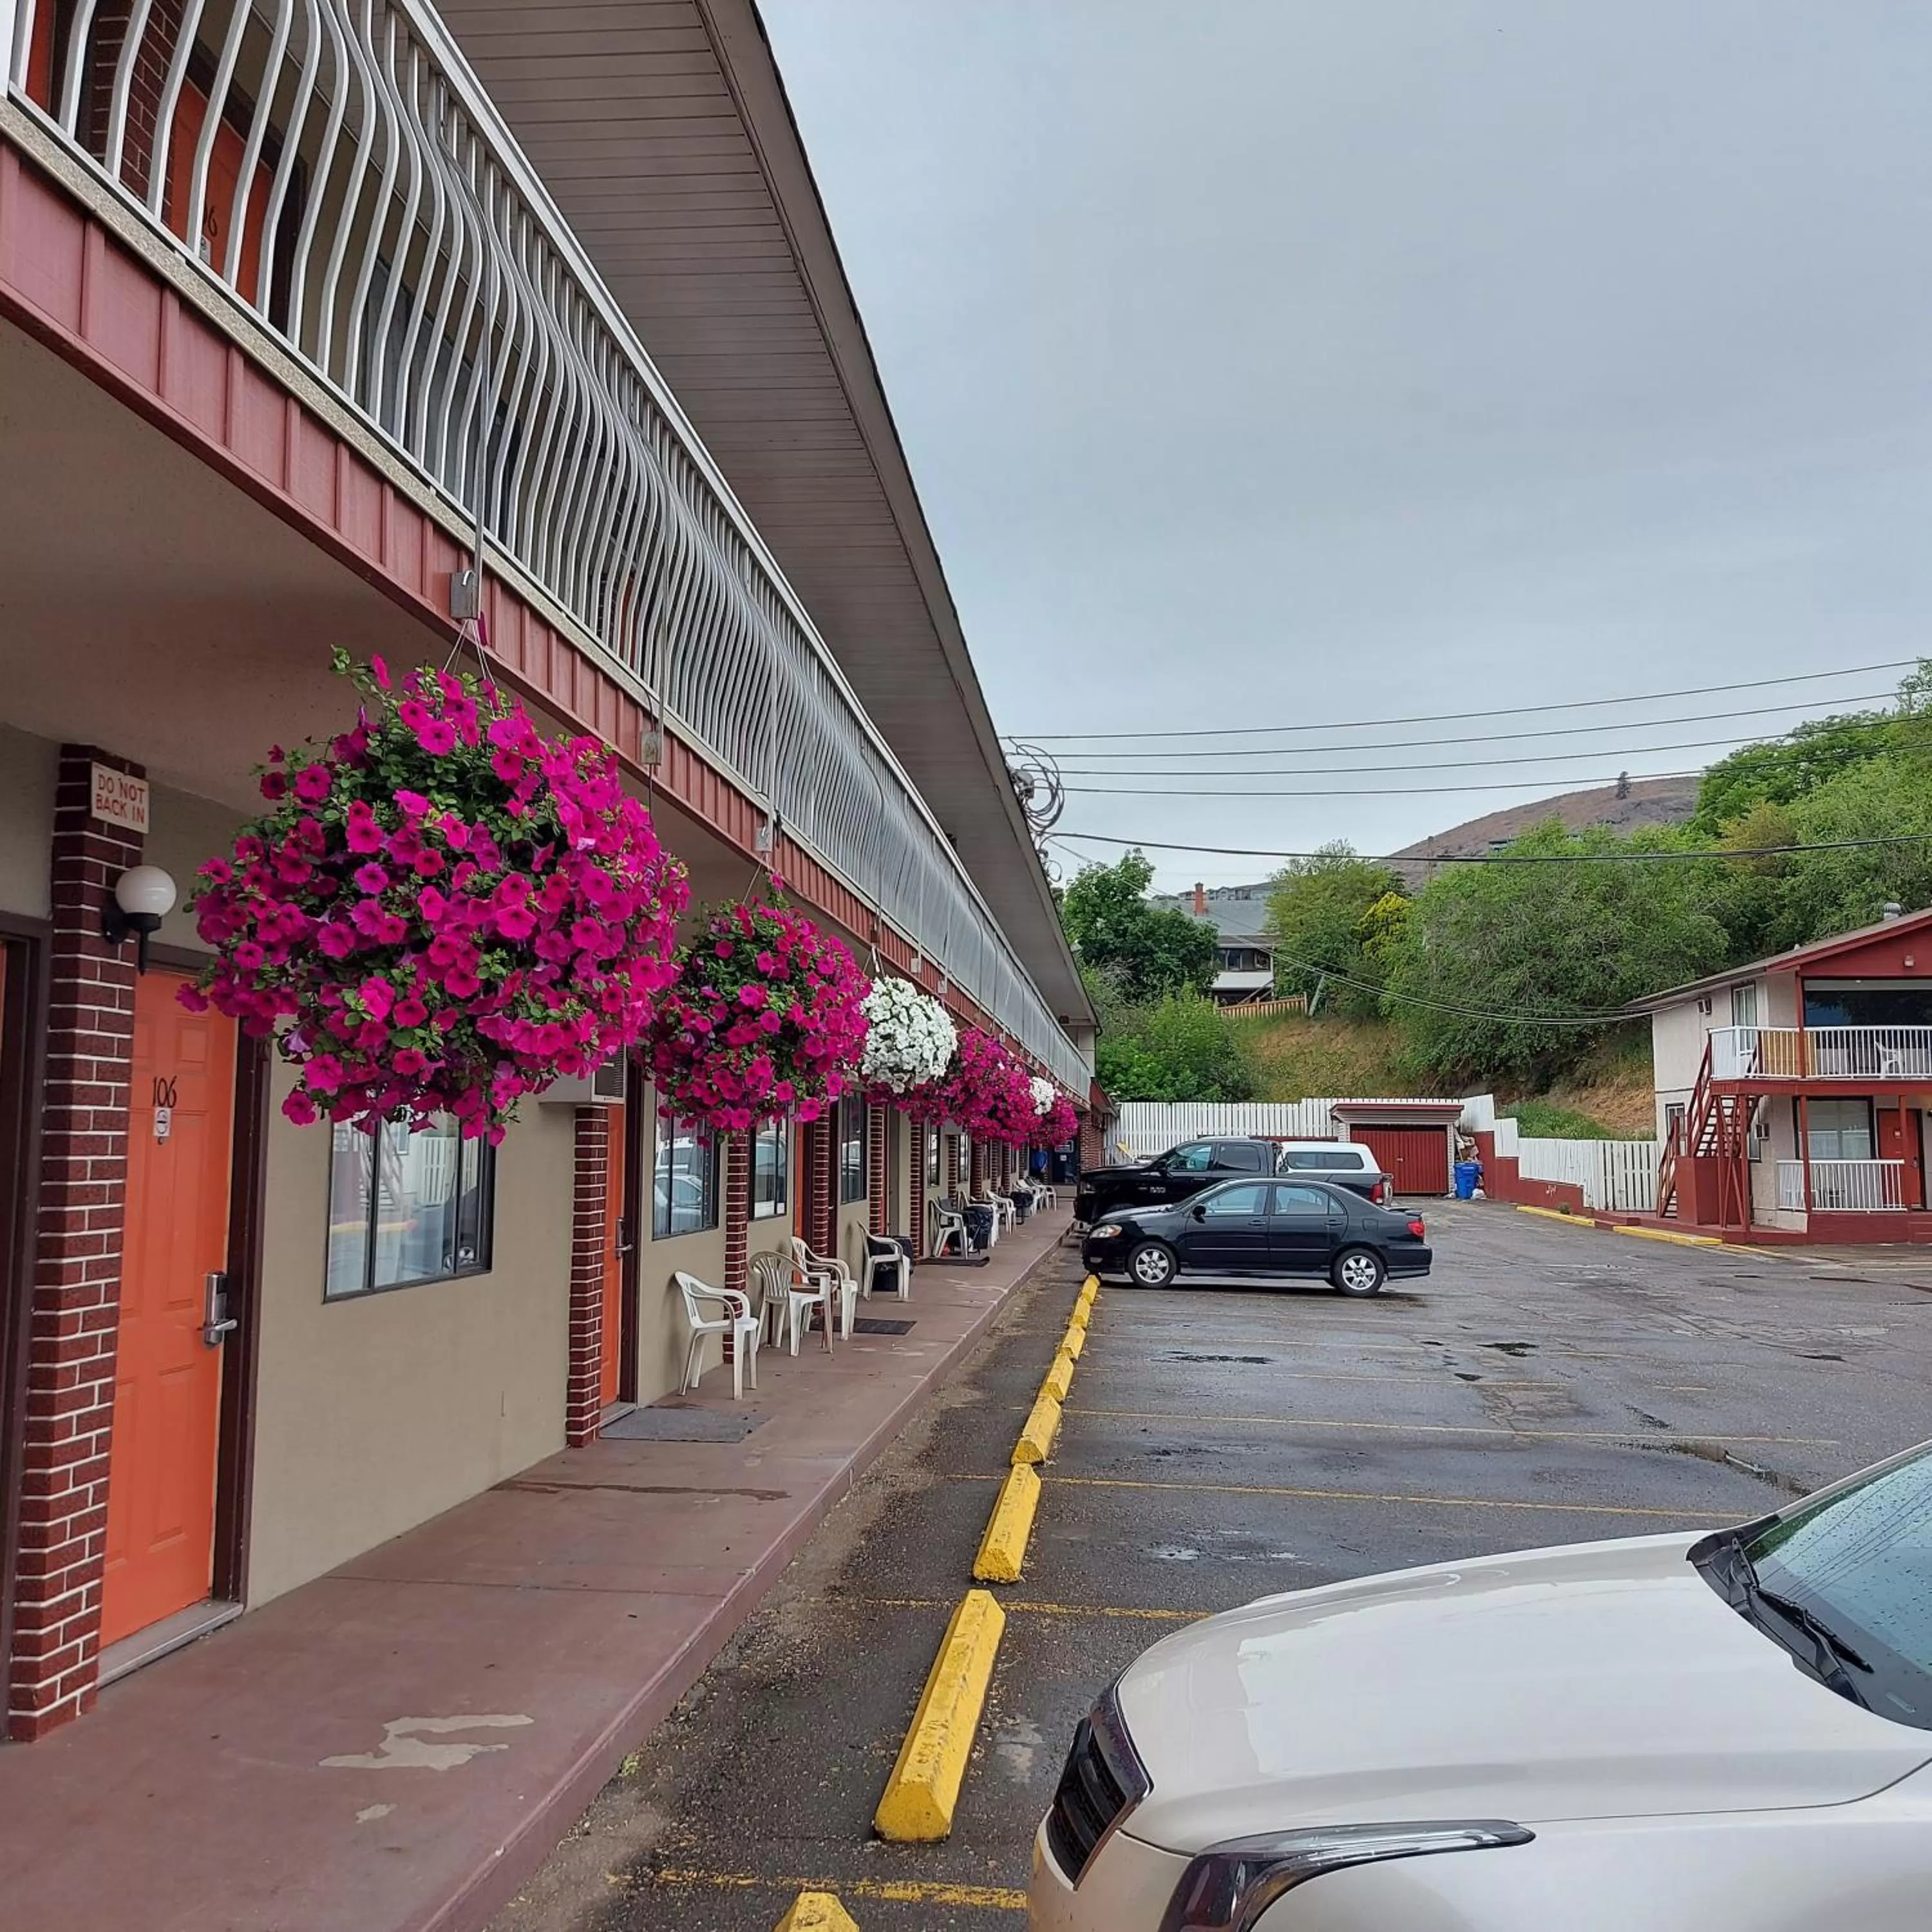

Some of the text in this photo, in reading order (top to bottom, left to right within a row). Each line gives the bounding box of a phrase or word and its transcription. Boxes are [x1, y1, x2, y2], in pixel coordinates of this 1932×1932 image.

[98, 773, 145, 804] DO NOT
[96, 793, 145, 825] BACK IN
[152, 1075, 178, 1108] 106
